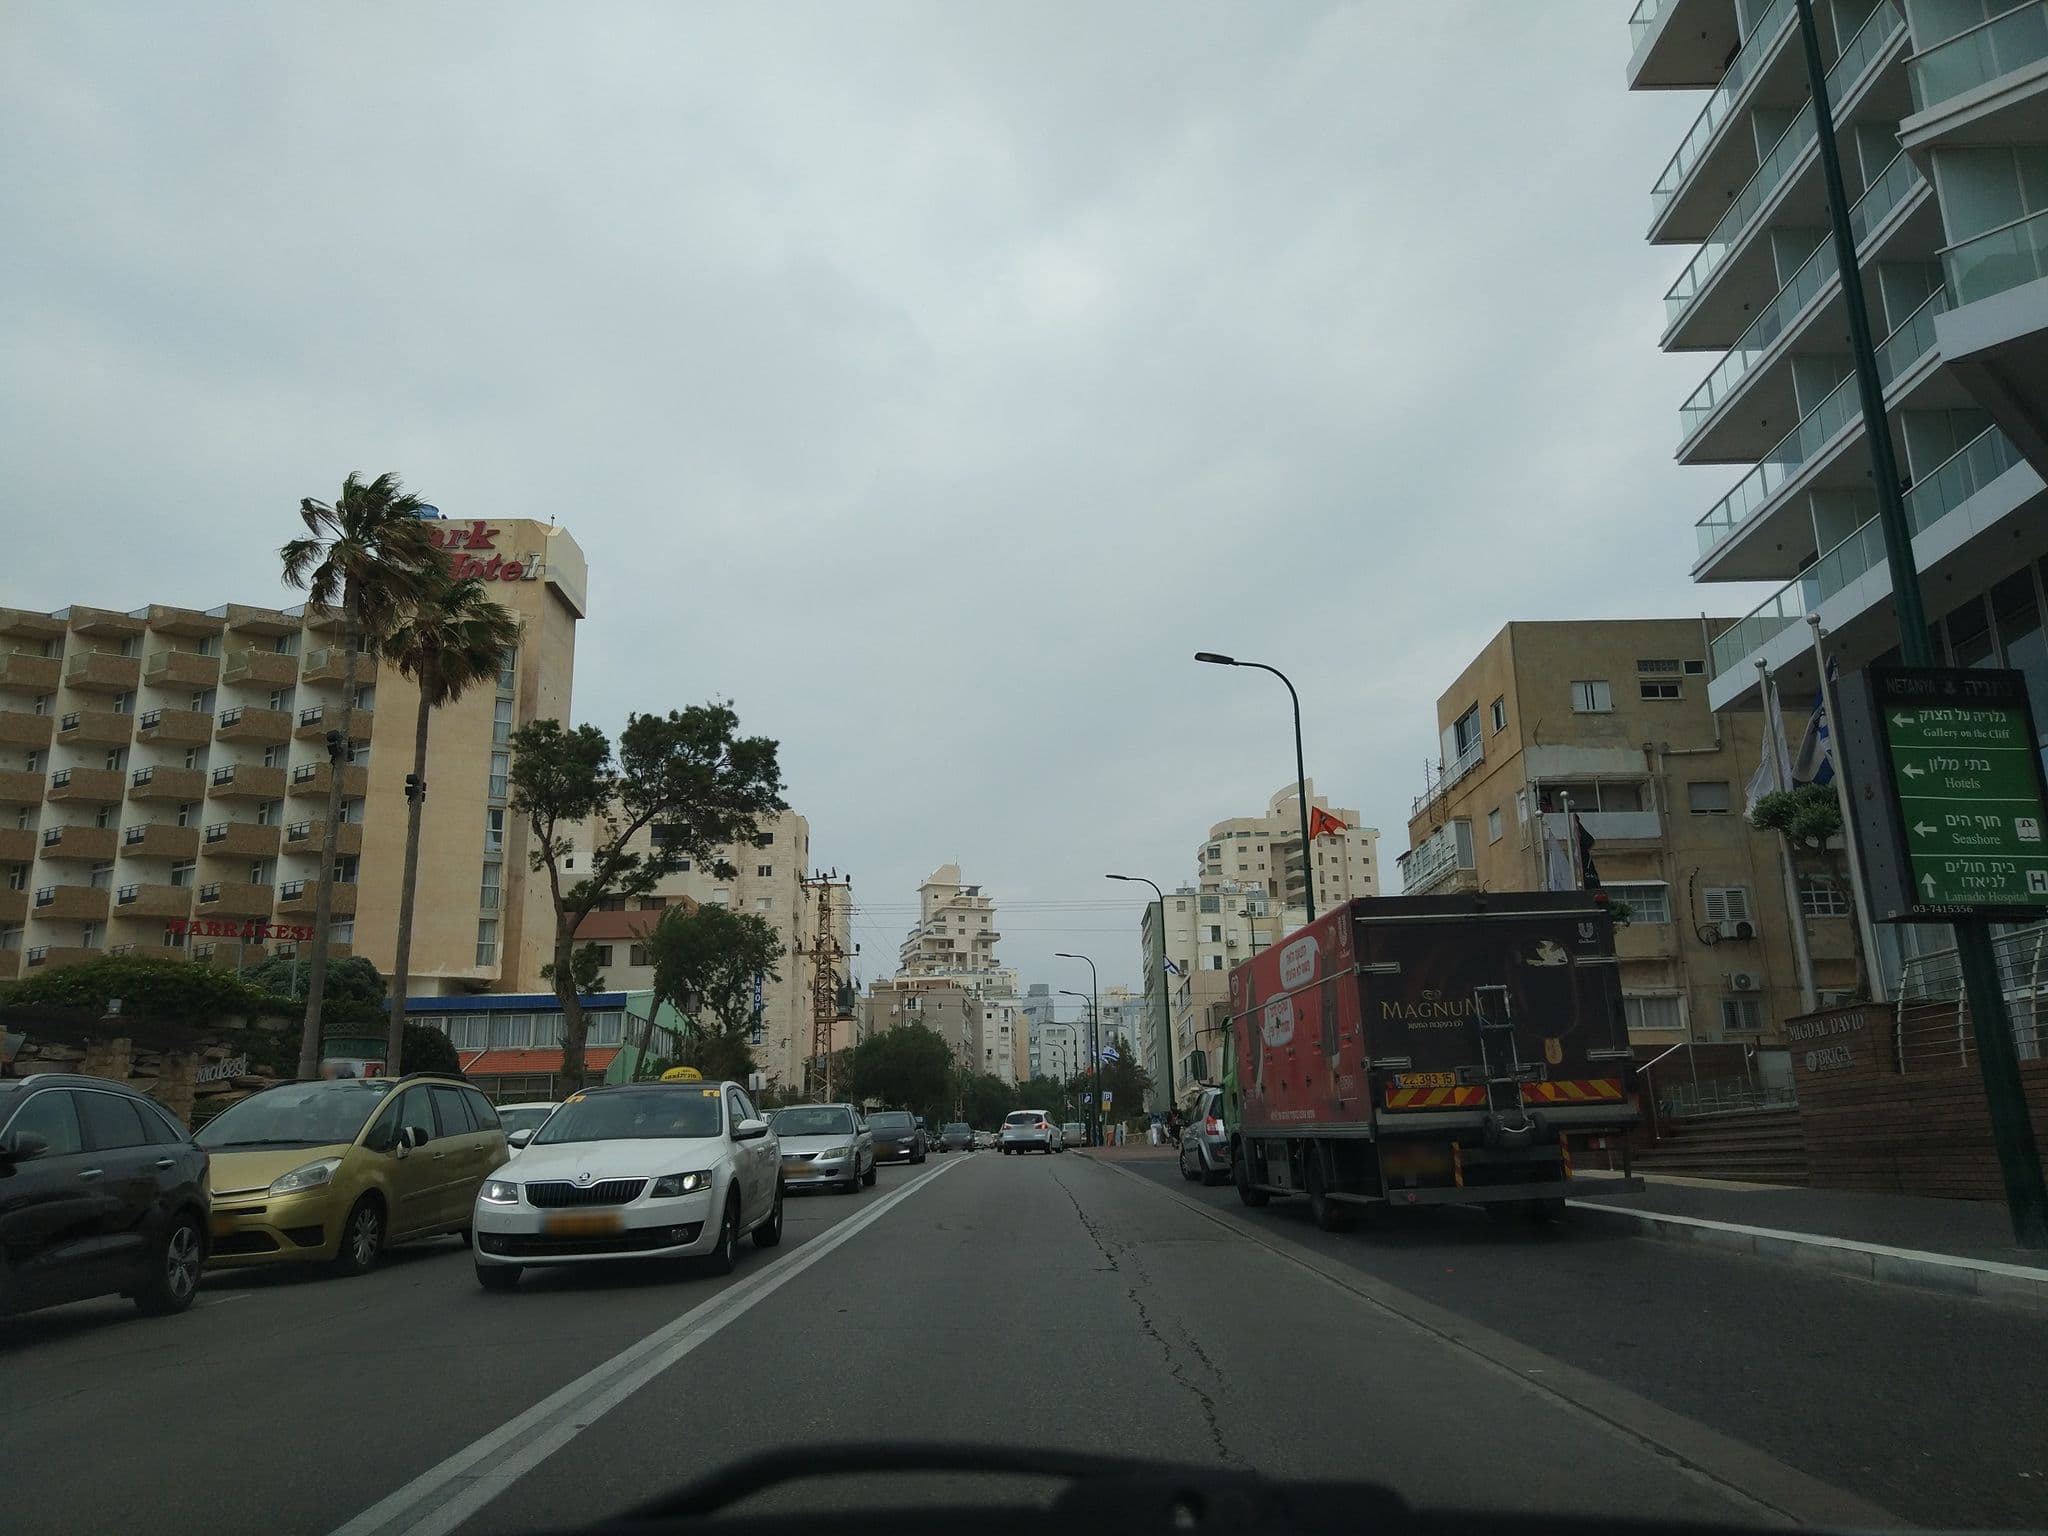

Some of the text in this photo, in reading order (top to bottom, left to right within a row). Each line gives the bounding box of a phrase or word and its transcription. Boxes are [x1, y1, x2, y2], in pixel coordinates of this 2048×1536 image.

[428, 520, 500, 550] ark
[450, 552, 541, 582] otel
[1887, 679, 1936, 696] NETANYA
[1919, 708, 2007, 724] גלריה על הצוק
[1923, 728, 2010, 740] Gallery on the Cliff
[1929, 755, 1992, 774] בתי מלון
[1945, 777, 1981, 789] Hotels
[1945, 814, 2001, 830] חוף הים
[1953, 833, 2001, 845] Seashore
[1945, 859, 2017, 874] בית חולים
[1961, 874, 2006, 888] לניאדו
[1945, 891, 2030, 904] Laniado Hospital
[1380, 998, 1485, 1020] MAGNUM
[1831, 1013, 1865, 1035] DAVID
